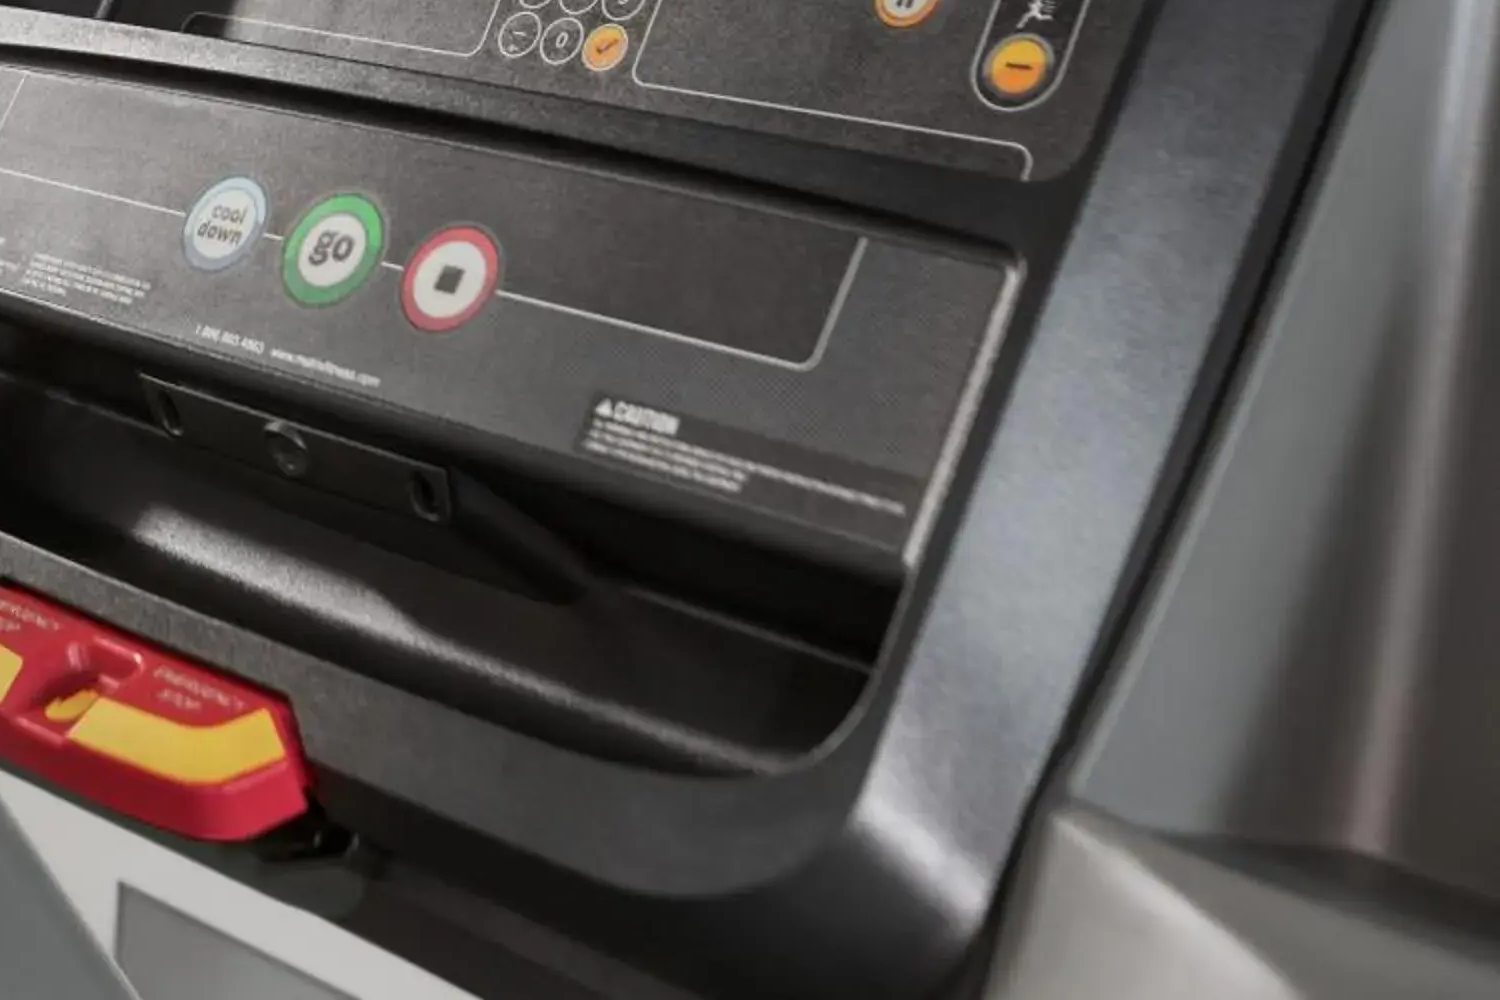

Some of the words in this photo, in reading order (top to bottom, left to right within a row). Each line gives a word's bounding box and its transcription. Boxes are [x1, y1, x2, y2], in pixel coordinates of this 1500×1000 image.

[555, 31, 569, 49] 0
[210, 203, 249, 226] cool
[196, 220, 244, 246] down
[307, 229, 356, 267] go
